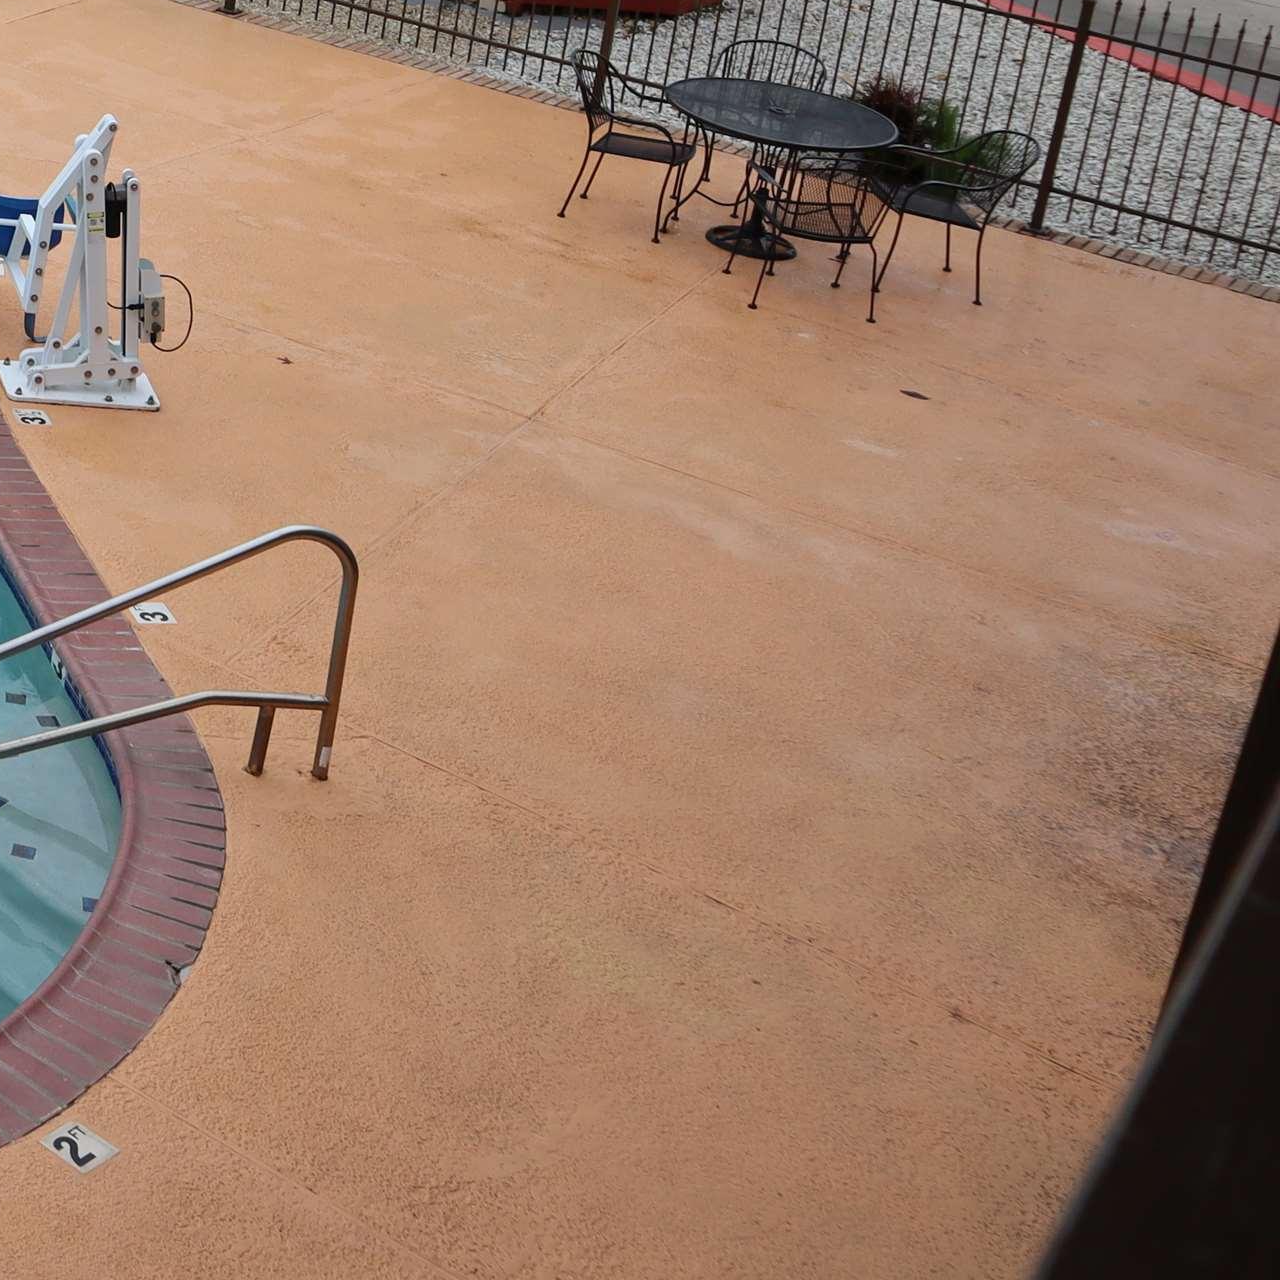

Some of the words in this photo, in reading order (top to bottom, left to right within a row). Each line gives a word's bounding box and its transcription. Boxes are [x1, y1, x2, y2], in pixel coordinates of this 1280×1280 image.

[20, 416, 47, 424] 3
[139, 611, 169, 622] 3
[67, 1125, 87, 1141] FT
[52, 1135, 97, 1168] 2
